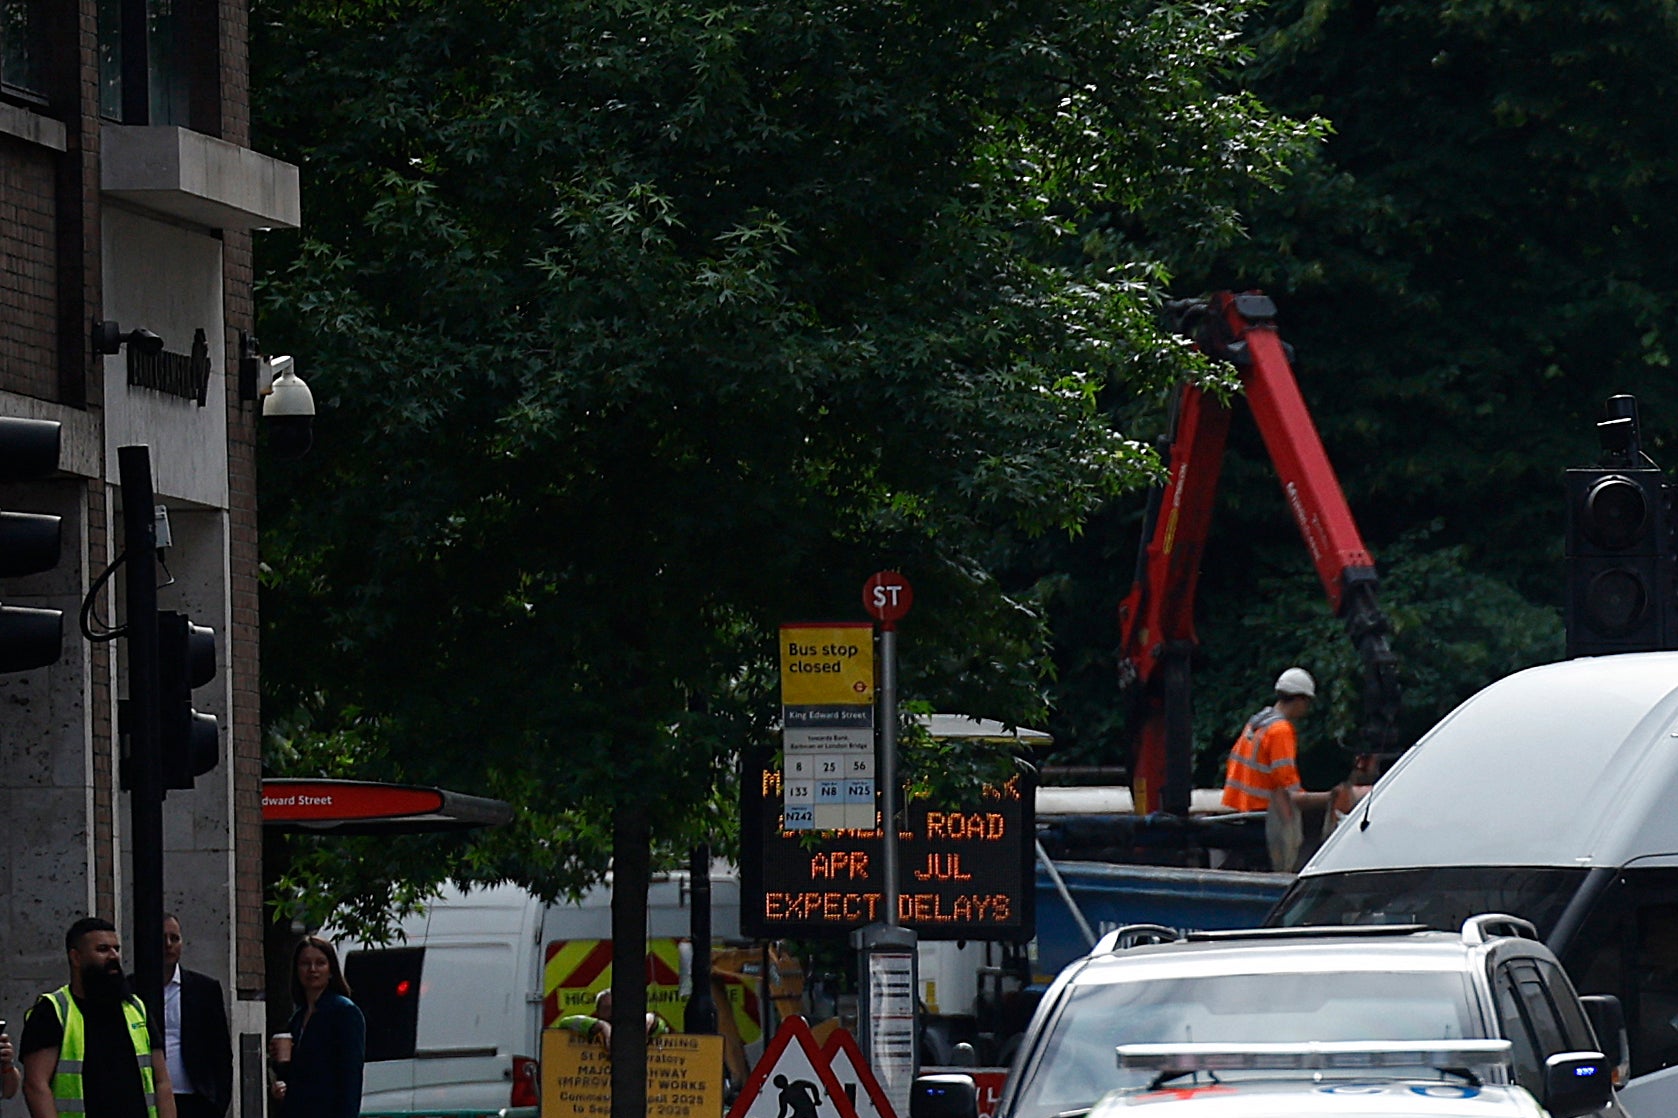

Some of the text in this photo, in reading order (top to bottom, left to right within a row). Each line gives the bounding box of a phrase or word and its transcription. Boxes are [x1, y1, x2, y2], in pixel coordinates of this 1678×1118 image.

[873, 585, 903, 608] ST
[789, 643, 858, 659] Bus stop
[789, 661, 841, 673] closed
[789, 711, 866, 721] King Edward Street
[796, 761, 866, 773] 8 25 56
[790, 786, 871, 797] 133 N8 N25
[261, 795, 333, 806] dward Street
[786, 811, 813, 821] N242
[926, 811, 1005, 840] ROAD
[811, 851, 973, 882] APR JUL
[766, 892, 1013, 922] EXPECT DELAYS
[659, 1080, 706, 1090] WORKS
[573, 1104, 584, 1113] to
